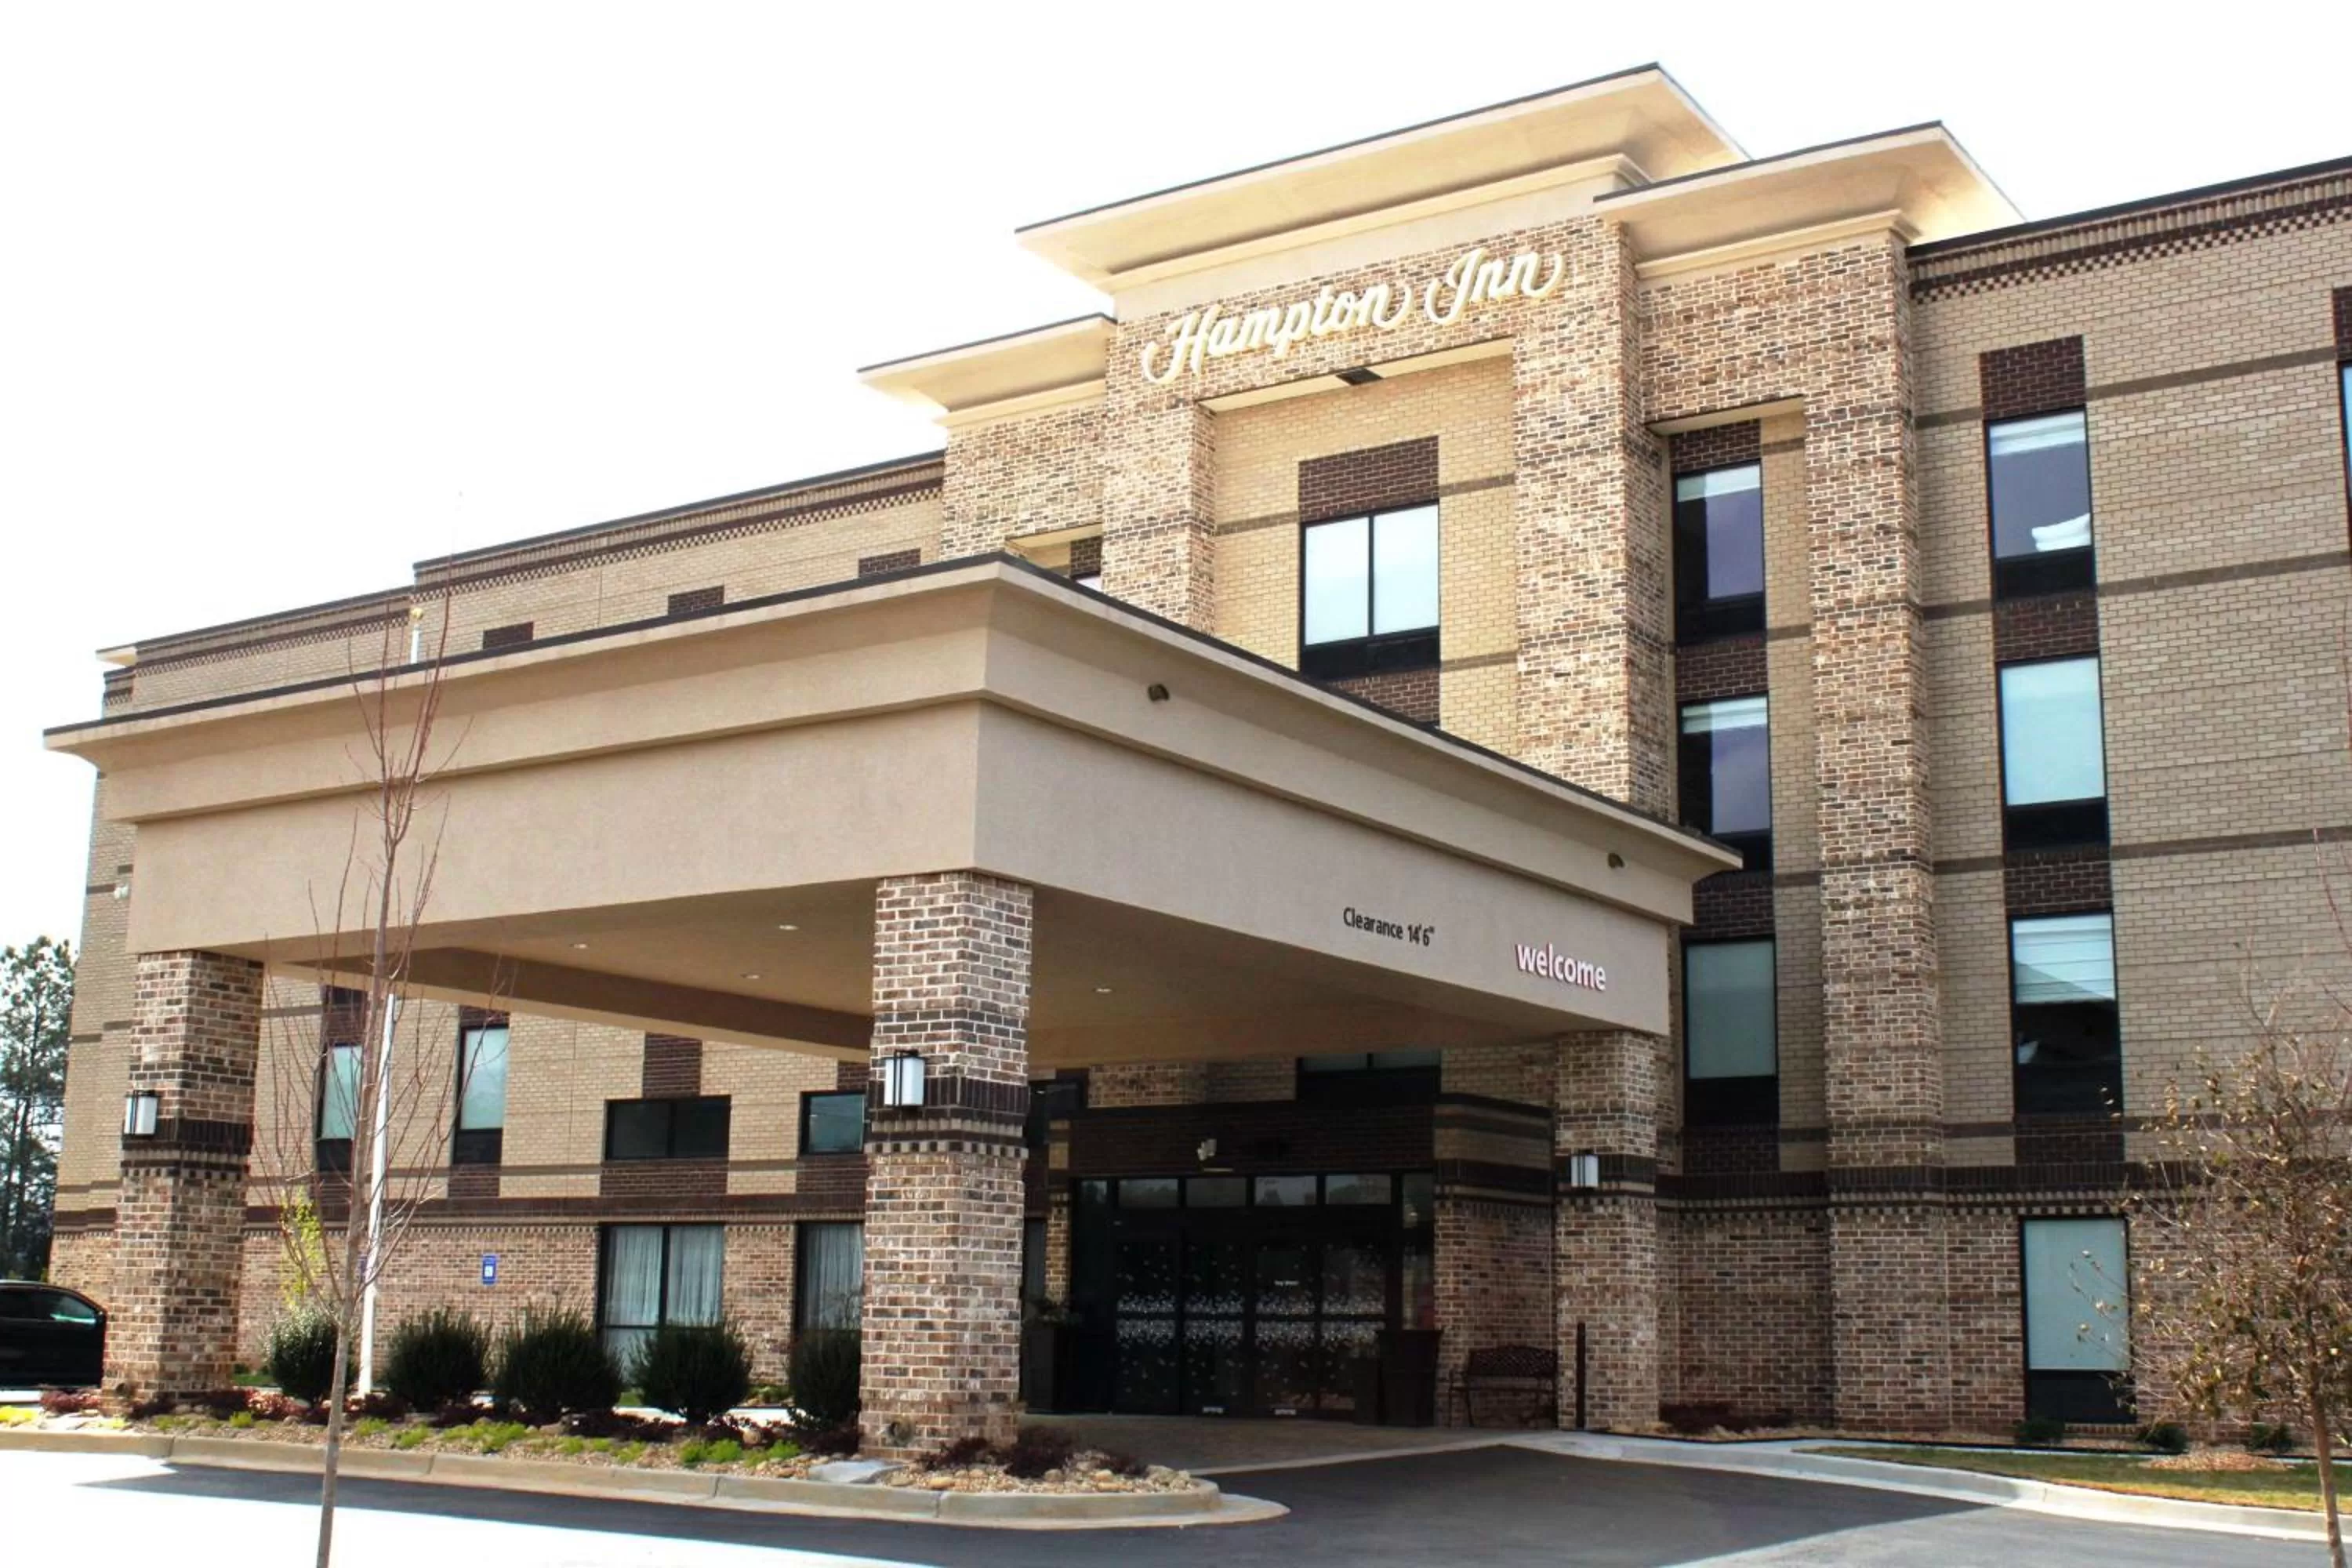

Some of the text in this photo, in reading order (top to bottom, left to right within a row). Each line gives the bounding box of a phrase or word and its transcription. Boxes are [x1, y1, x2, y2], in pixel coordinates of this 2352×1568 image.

[1142, 248, 1565, 385] Hampton Inn
[1343, 906, 1403, 940] Clearance
[1515, 942, 1606, 992] welcome
